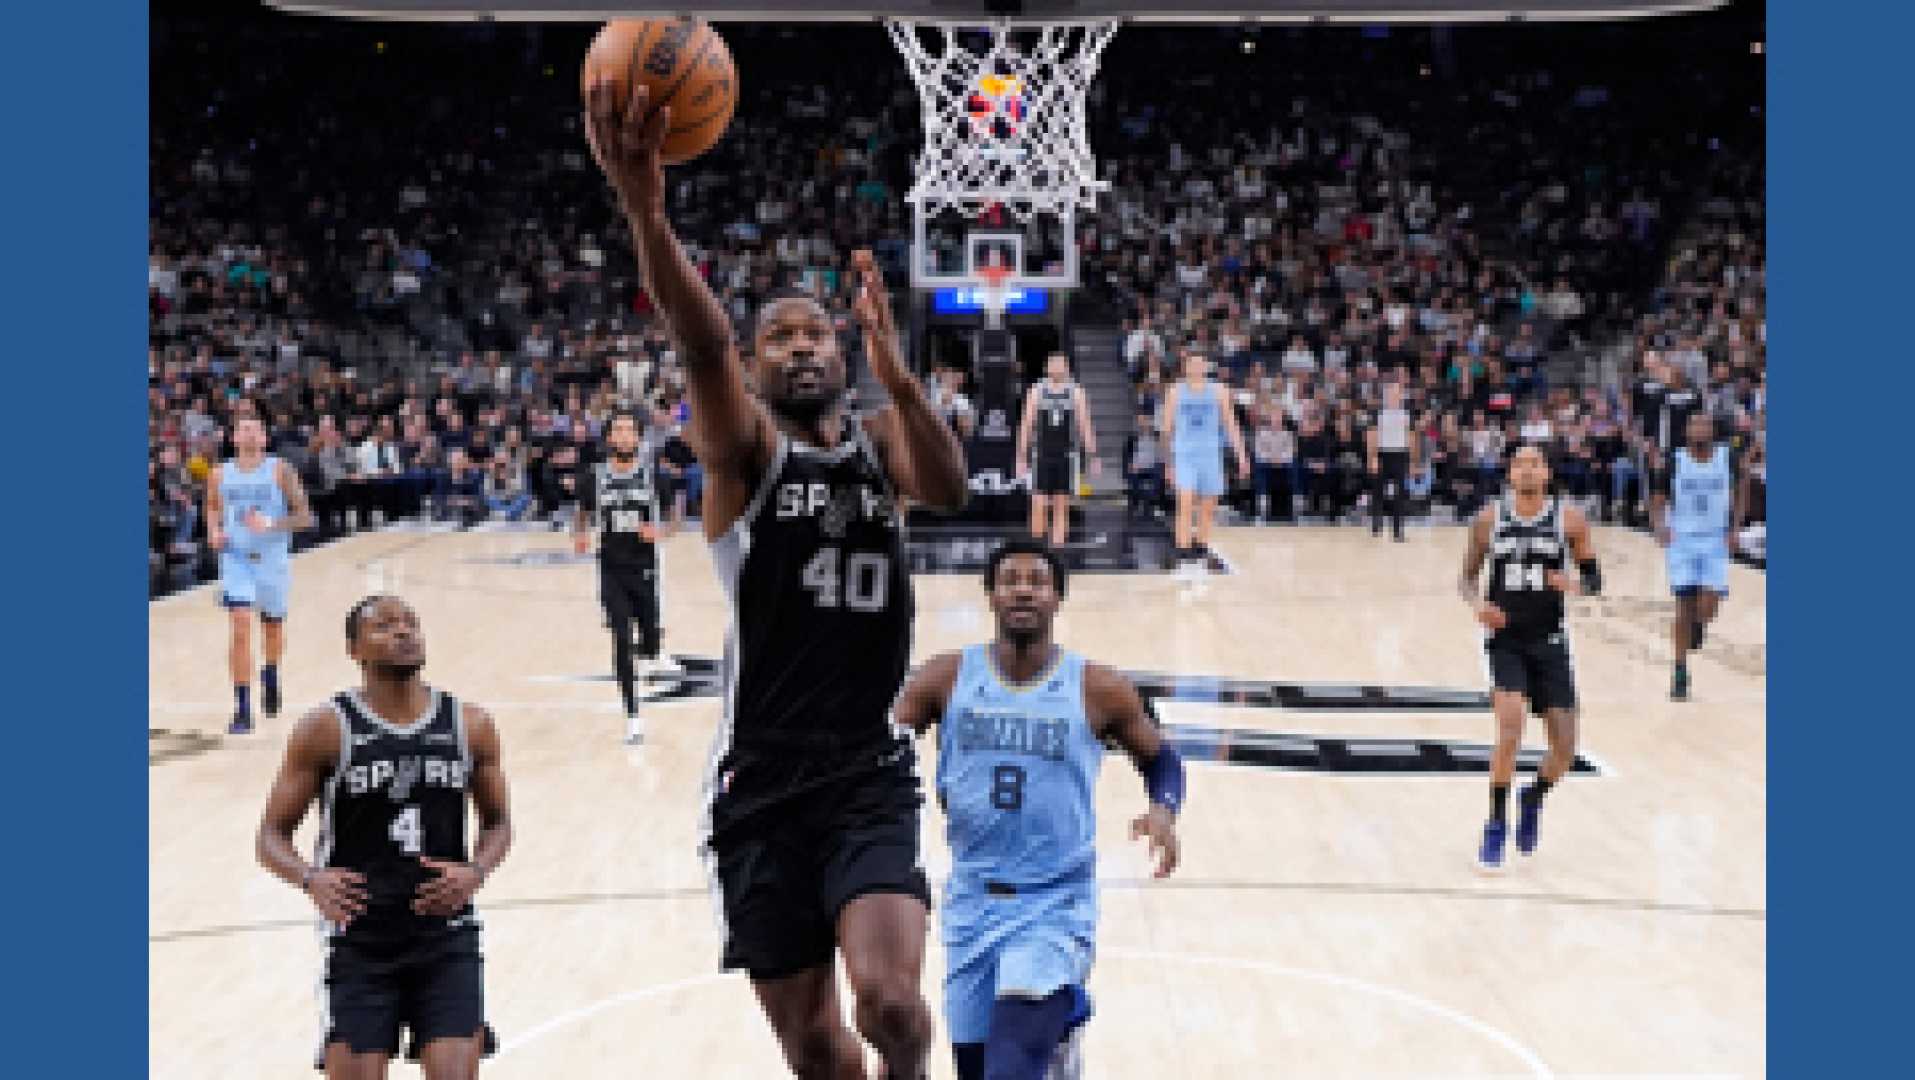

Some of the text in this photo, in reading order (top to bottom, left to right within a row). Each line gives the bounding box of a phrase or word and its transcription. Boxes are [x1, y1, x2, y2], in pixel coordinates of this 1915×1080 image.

[802, 547, 888, 612] 40
[991, 763, 1027, 811] 8
[388, 804, 423, 855] 4
